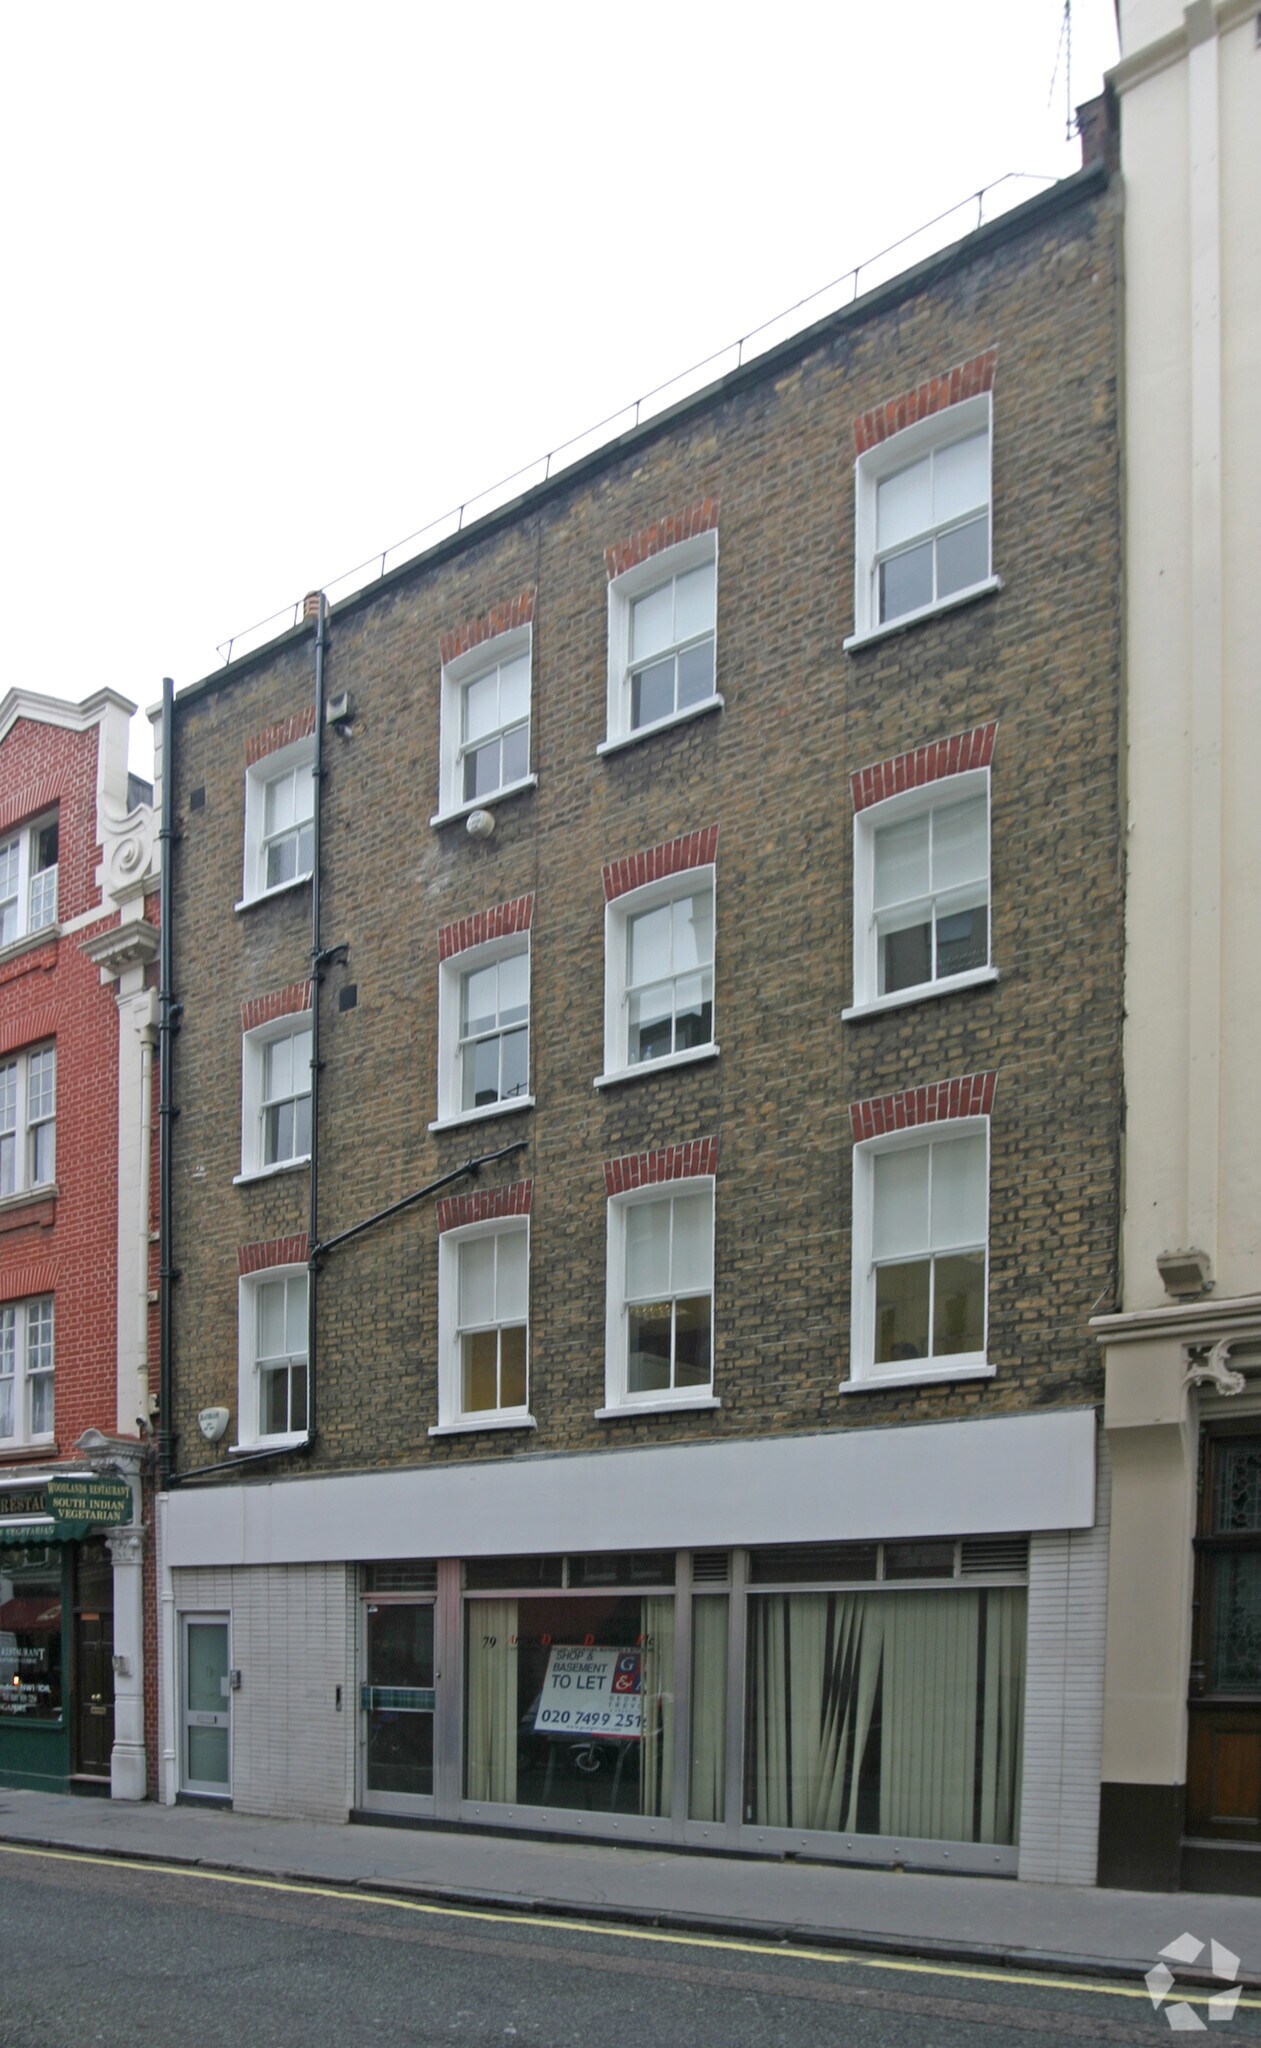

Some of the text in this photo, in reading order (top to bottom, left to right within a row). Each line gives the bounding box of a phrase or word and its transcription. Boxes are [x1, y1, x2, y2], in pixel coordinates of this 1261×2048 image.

[48, 1482, 130, 1499] WOODLANDS RESTAURANT
[53, 1497, 125, 1510] SOUTH INDIAN
[58, 1508, 121, 1521] VEGETARIAN
[482, 1635, 497, 1649] 79
[555, 1650, 584, 1661] SHOP
[552, 1662, 608, 1674] BASEMENT
[551, 1674, 607, 1690] TO LET
[541, 1709, 571, 1724] 020
[575, 1711, 611, 1726] 7499
